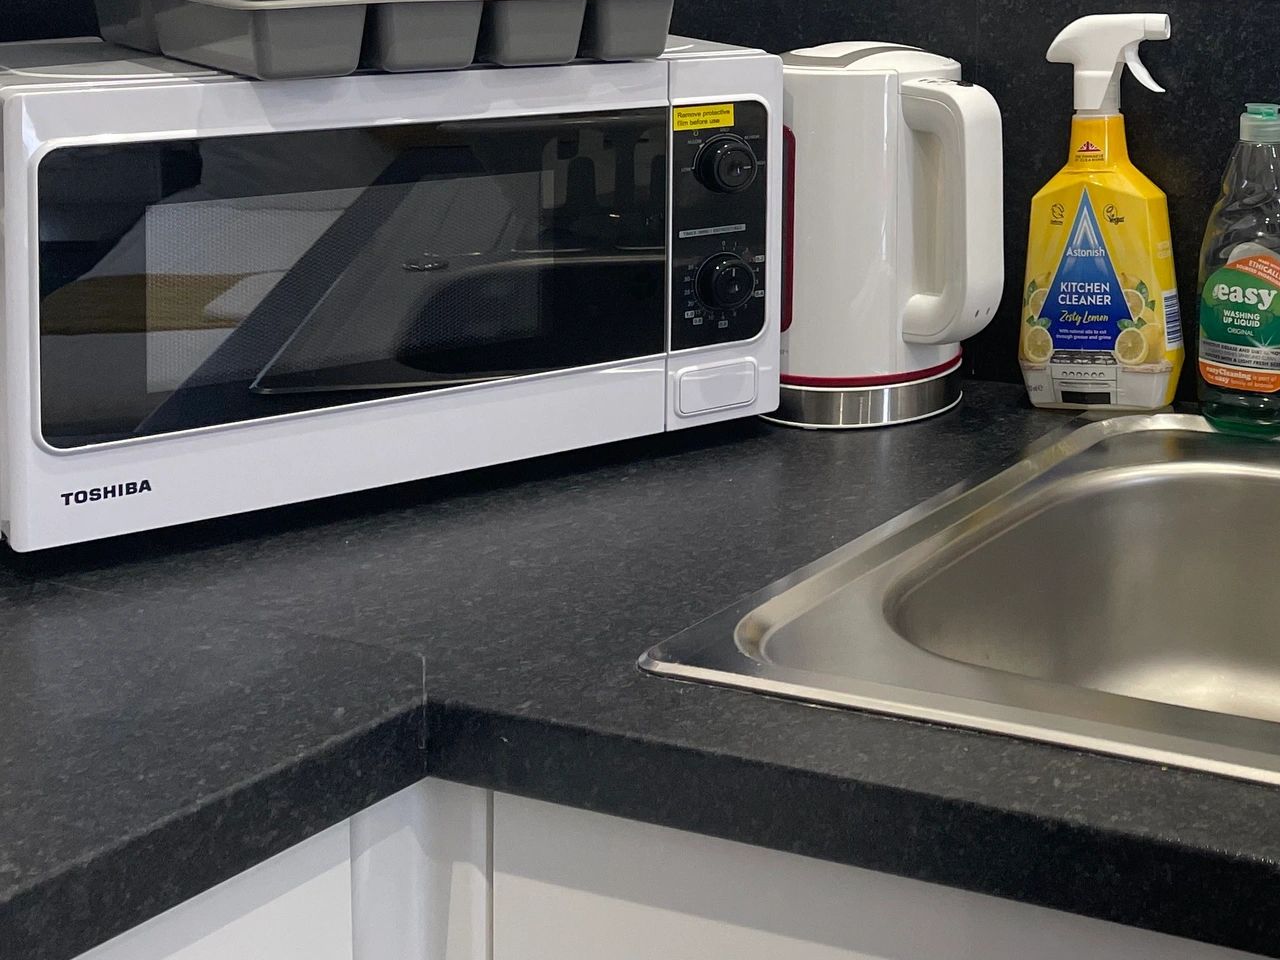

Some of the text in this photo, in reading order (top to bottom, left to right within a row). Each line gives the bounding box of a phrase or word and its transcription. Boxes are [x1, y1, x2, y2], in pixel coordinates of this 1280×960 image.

[702, 109, 730, 118] protective
[1065, 246, 1105, 257] Astonish
[1060, 282, 1110, 293] KITCHEN
[1058, 294, 1112, 305] CLEANER
[1214, 283, 1278, 310] easy
[1059, 309, 1109, 326] Zesty Lemon
[1223, 309, 1260, 320] WASHING
[1234, 318, 1260, 327] LIQUID
[1227, 326, 1254, 336] ORIGINAL
[1214, 375, 1230, 384] easy
[60, 479, 152, 506] TOSHIBA
